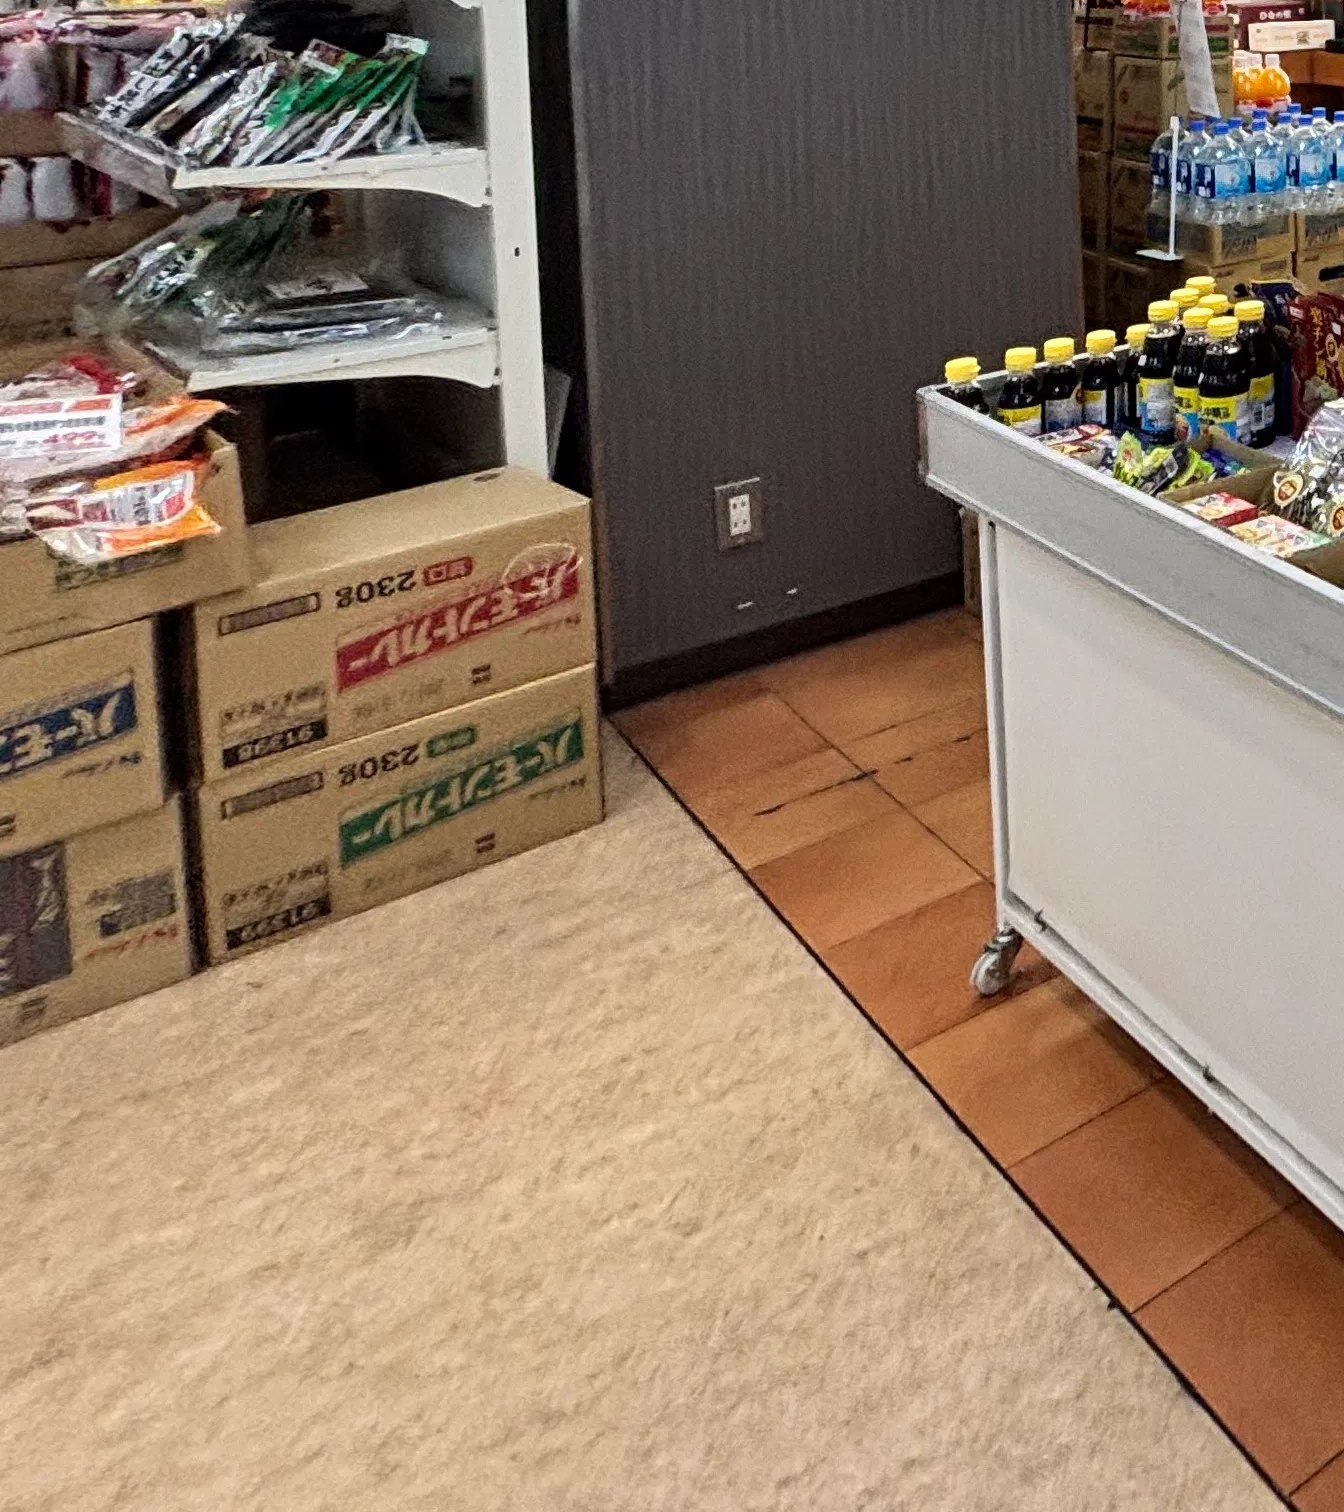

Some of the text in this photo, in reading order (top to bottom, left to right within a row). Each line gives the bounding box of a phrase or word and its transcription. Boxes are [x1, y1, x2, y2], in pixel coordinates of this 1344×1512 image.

[336, 571, 417, 608] 230g
[349, 562, 568, 670] バーモントカレー
[339, 746, 420, 787] 230g
[351, 724, 572, 846] バーモントカレー
